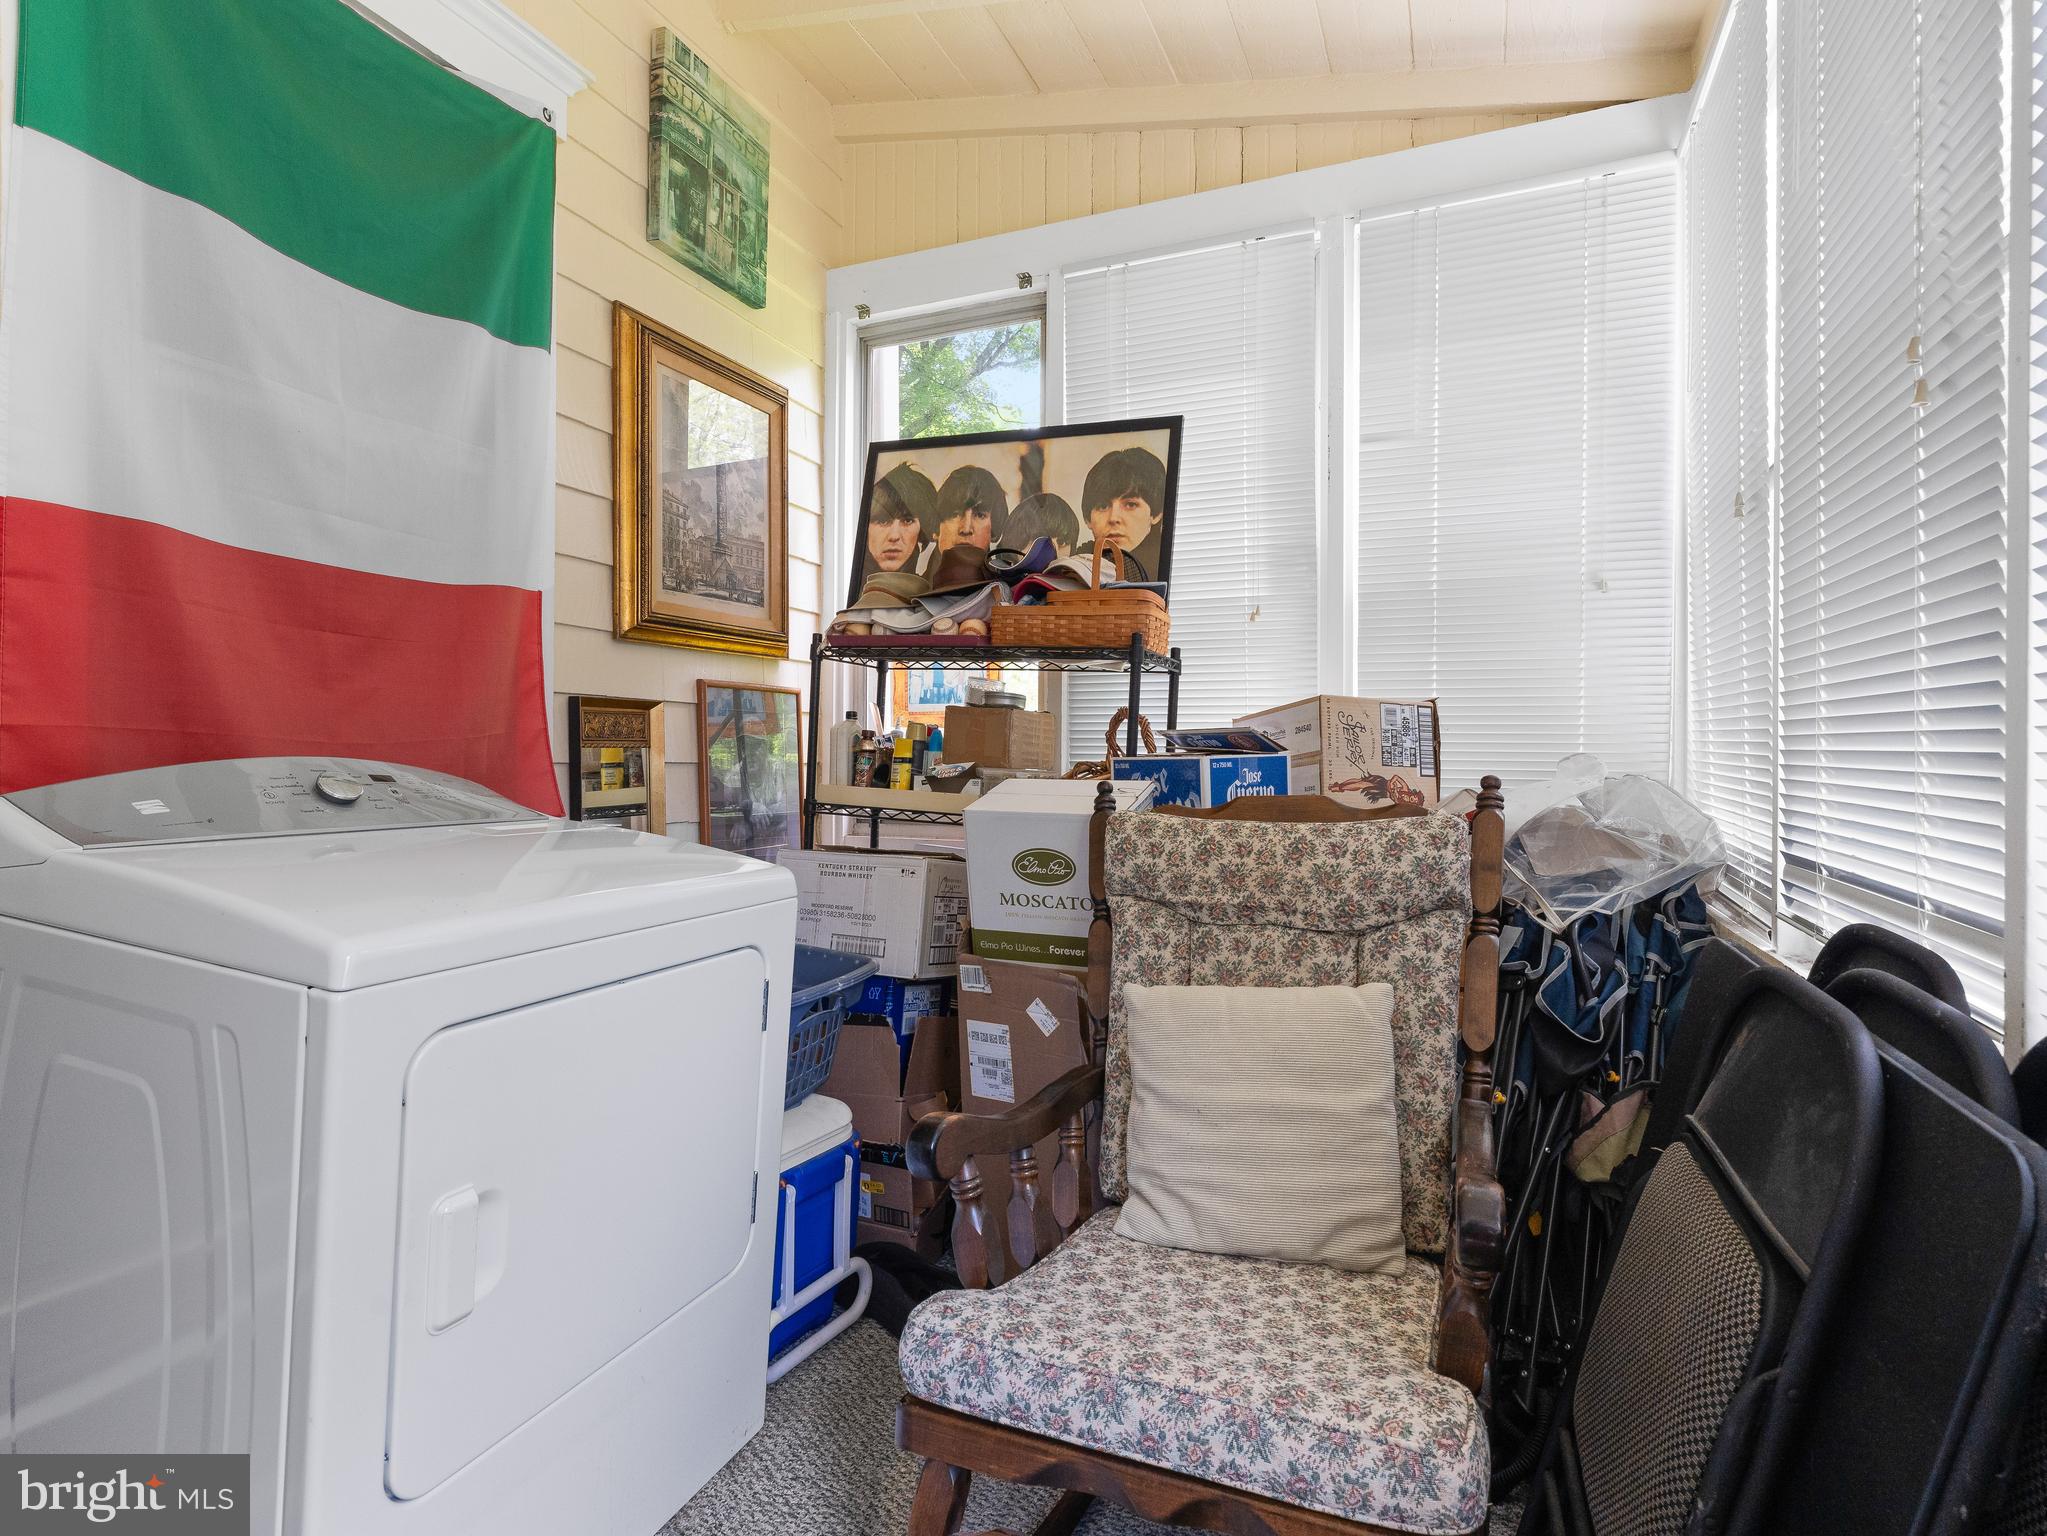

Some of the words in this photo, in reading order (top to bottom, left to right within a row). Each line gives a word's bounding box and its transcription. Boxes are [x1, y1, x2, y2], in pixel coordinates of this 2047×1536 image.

[1242, 768, 1262, 787] Jose
[1226, 779, 1275, 802] Cuervo
[818, 863, 848, 871] KENTUCKY
[1018, 856, 1047, 874] Elmo
[819, 870, 847, 878] BOURBON
[847, 872, 873, 880] WHISKEY
[999, 892, 1094, 912] MOSCATO
[980, 940, 999, 950] Elmo
[1001, 941, 1014, 951] Pio
